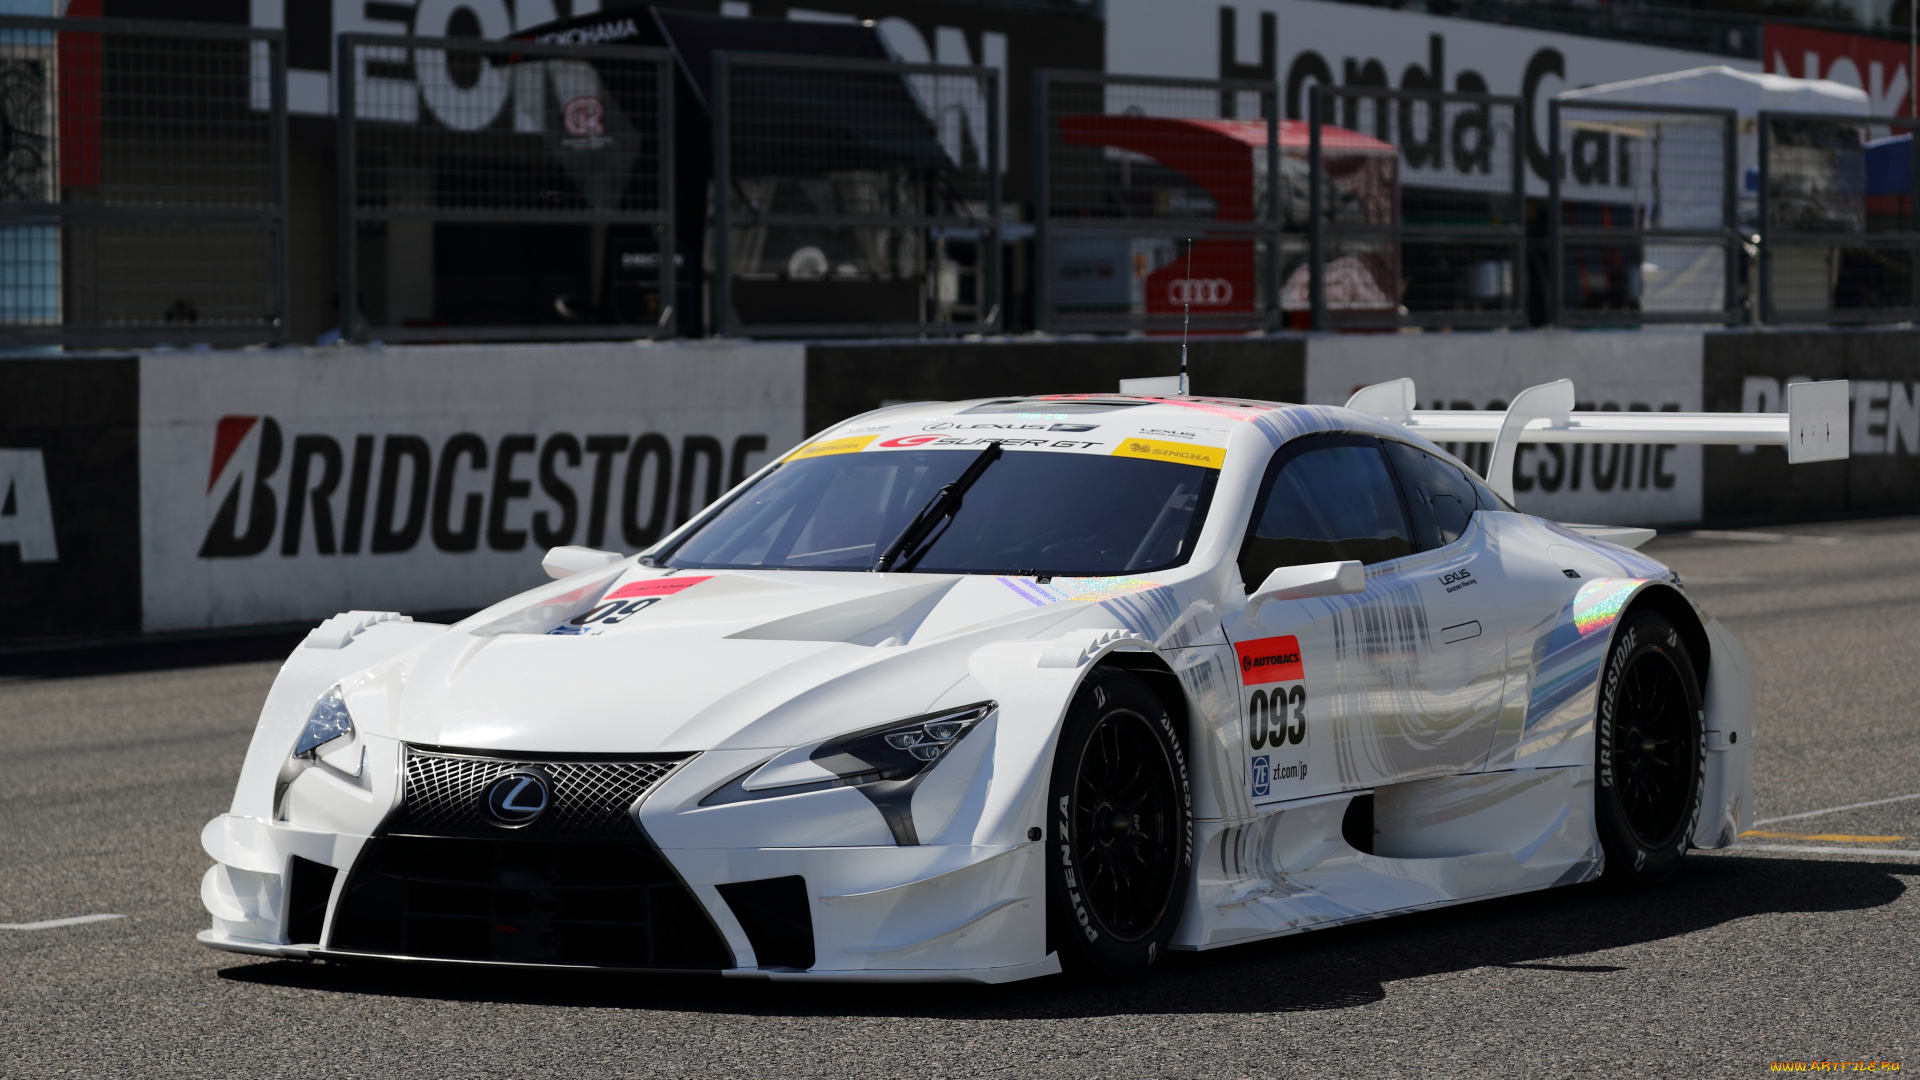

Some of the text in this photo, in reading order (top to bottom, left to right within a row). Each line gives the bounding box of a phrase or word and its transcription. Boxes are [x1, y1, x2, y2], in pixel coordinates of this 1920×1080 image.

[1221, 7, 1491, 173] Honda
[956, 423, 1047, 431] LEXUS
[932, 437, 1104, 449] SUPER GT
[1152, 448, 1210, 462] SINGHA
[1438, 569, 1471, 585] LEXUS
[1253, 653, 1300, 667] AUTOBACS
[1250, 684, 1306, 750] 093
[1600, 626, 1637, 787] BRIDGESTONE
[1254, 764, 1269, 788] ZF
[1273, 760, 1308, 781] zf.com/jp
[1161, 710, 1193, 868] BRIDGESTONE
[1060, 794, 1098, 943] POTENZA
